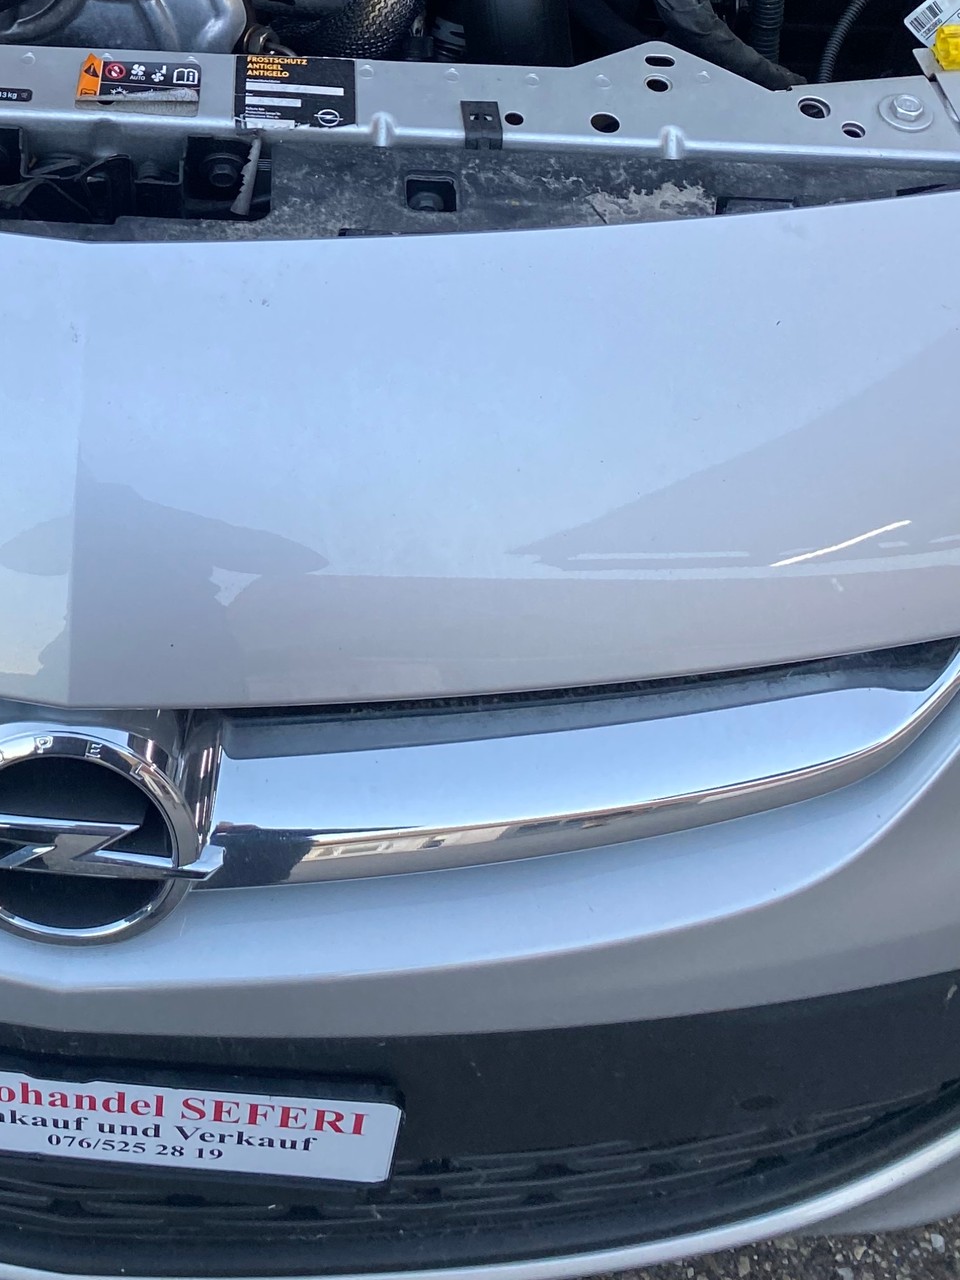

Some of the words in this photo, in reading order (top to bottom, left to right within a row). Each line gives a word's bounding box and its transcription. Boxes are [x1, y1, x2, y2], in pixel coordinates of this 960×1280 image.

[246, 55, 308, 65] FROSTSCHUTZ
[246, 63, 284, 71] ANTIGEL
[246, 70, 290, 78] ANTIGELO
[181, 1097, 369, 1136] SEFERI
[97, 1122, 162, 1139] und
[173, 1125, 318, 1152] Verkauf
[47, 1133, 146, 1154] 076/525
[155, 1144, 185, 1158] 28
[197, 1147, 223, 1160] 19
